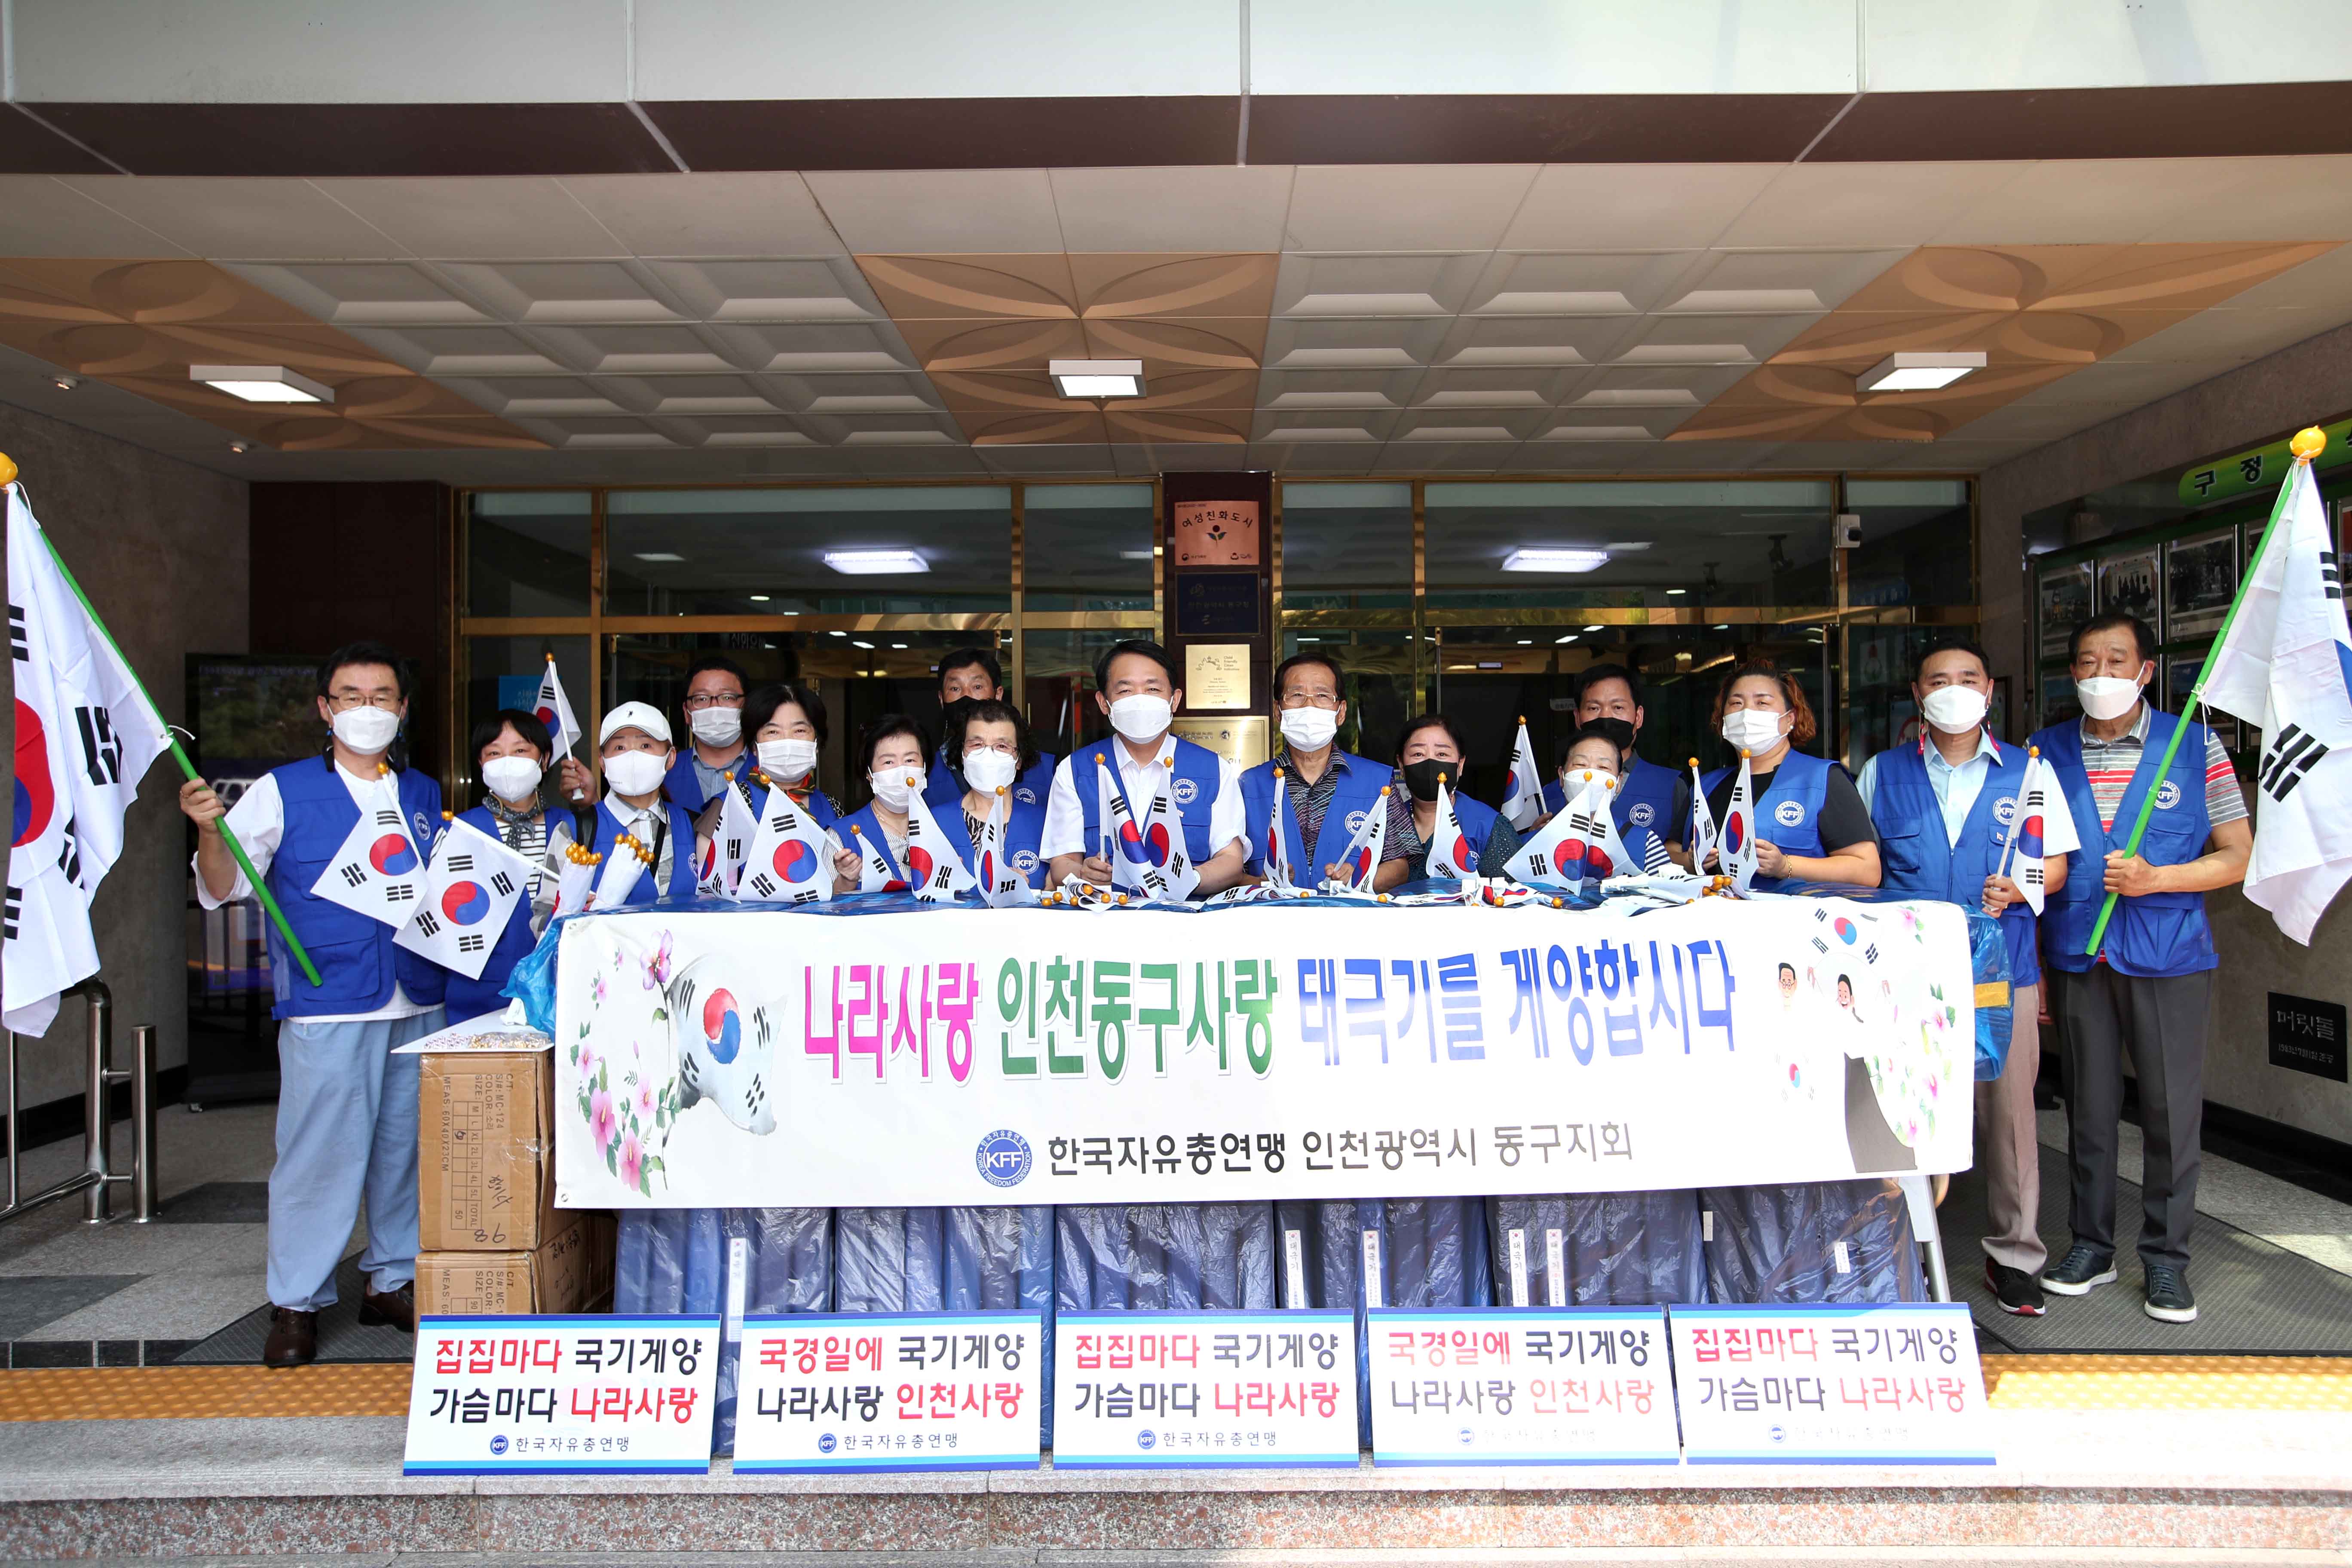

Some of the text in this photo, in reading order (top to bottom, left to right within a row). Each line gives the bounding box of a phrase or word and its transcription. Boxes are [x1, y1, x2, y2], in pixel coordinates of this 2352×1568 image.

[1182, 511, 1253, 528] 여성친화도시
[1635, 812, 1650, 820] KFF
[1781, 810, 1799, 818] KFF
[805, 938, 1736, 1082] 나라사랑 인천동구사랑 태극기를 게양합시다
[2277, 1011, 2334, 1041] 머릿돌
[471, 1132, 478, 1142] XL
[981, 1130, 1026, 1146] 한국자유총연맹
[1049, 1122, 1632, 1176] 한국자유총연맹 인천광역시 동구지회
[471, 1147, 478, 1156] 2L
[471, 1161, 478, 1170] 3L
[986, 1152, 1022, 1168] KFF
[471, 1175, 478, 1183] 4L
[977, 1151, 1032, 1187] KOREA FREEDOM FEDERATION
[471, 1189, 478, 1198] 5L
[455, 1210, 463, 1220] 50
[1289, 1241, 1298, 1271] 태극기
[1368, 1243, 1376, 1271] 태극기
[485, 1271, 493, 1310] COLOR:
[471, 1301, 478, 1310] 90
[436, 1338, 702, 1375] 집집마다 국기게양
[760, 1334, 1024, 1374] 국경일에 국기게양
[1076, 1333, 1338, 1370] 집집마다 국기게양
[1389, 1330, 1650, 1367] 국경일에 국기게양
[1692, 1328, 1957, 1364] 집집마다 국기게양
[430, 1387, 698, 1424] 가슴마다 나라사랑
[757, 1382, 1024, 1422] 나라사랑 인천사랑
[1075, 1382, 1340, 1418] 가슴마다 나라사랑
[1392, 1379, 1654, 1415] 나라사랑 인천사랑
[1699, 1377, 1965, 1412] 가슴마다 나라사랑
[493, 1442, 506, 1450] KFF
[516, 1436, 629, 1452] 한국자유총연맹
[844, 1433, 958, 1450] 한국자유총연맹
[1163, 1432, 1276, 1446] 한국자유총연맹
